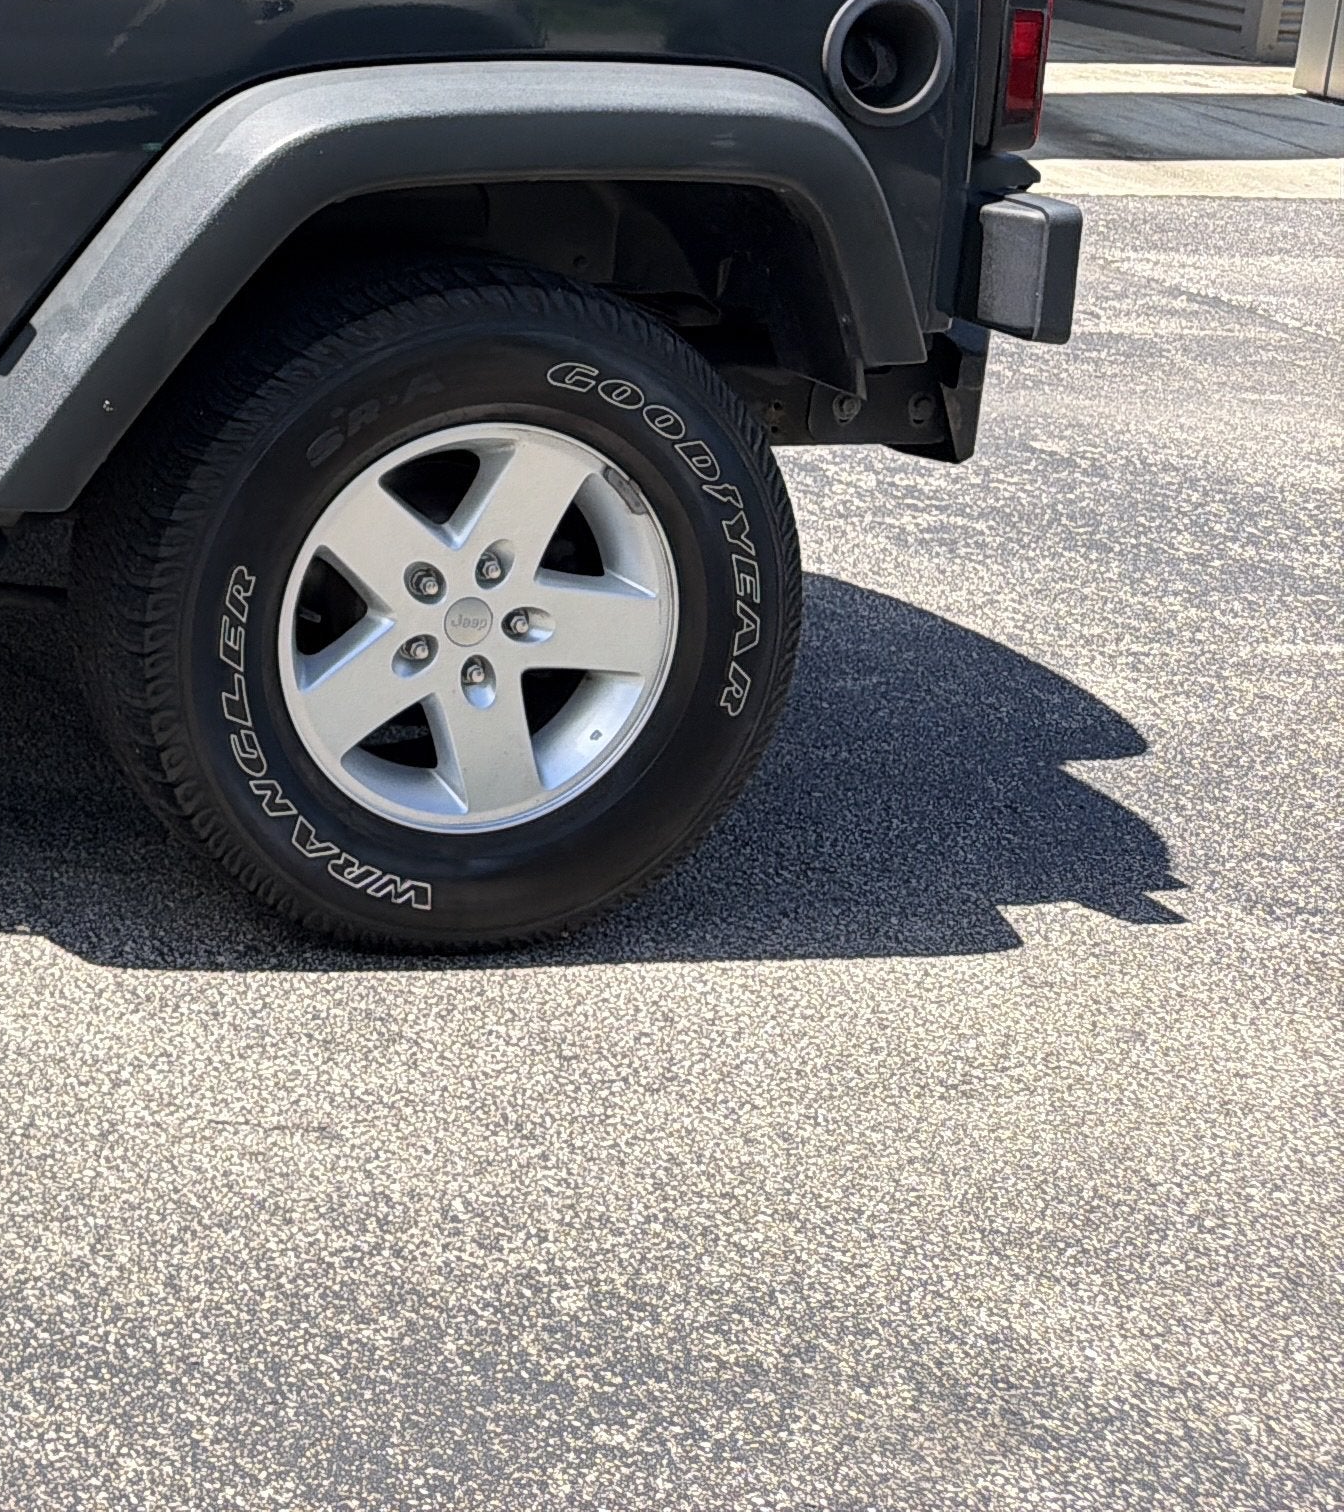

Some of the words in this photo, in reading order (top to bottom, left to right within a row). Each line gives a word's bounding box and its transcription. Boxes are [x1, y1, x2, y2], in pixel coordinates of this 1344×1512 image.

[450, 613, 488, 632] Jeep
[546, 361, 761, 717] GOODYEAR
[220, 564, 433, 910] WRANGLER
